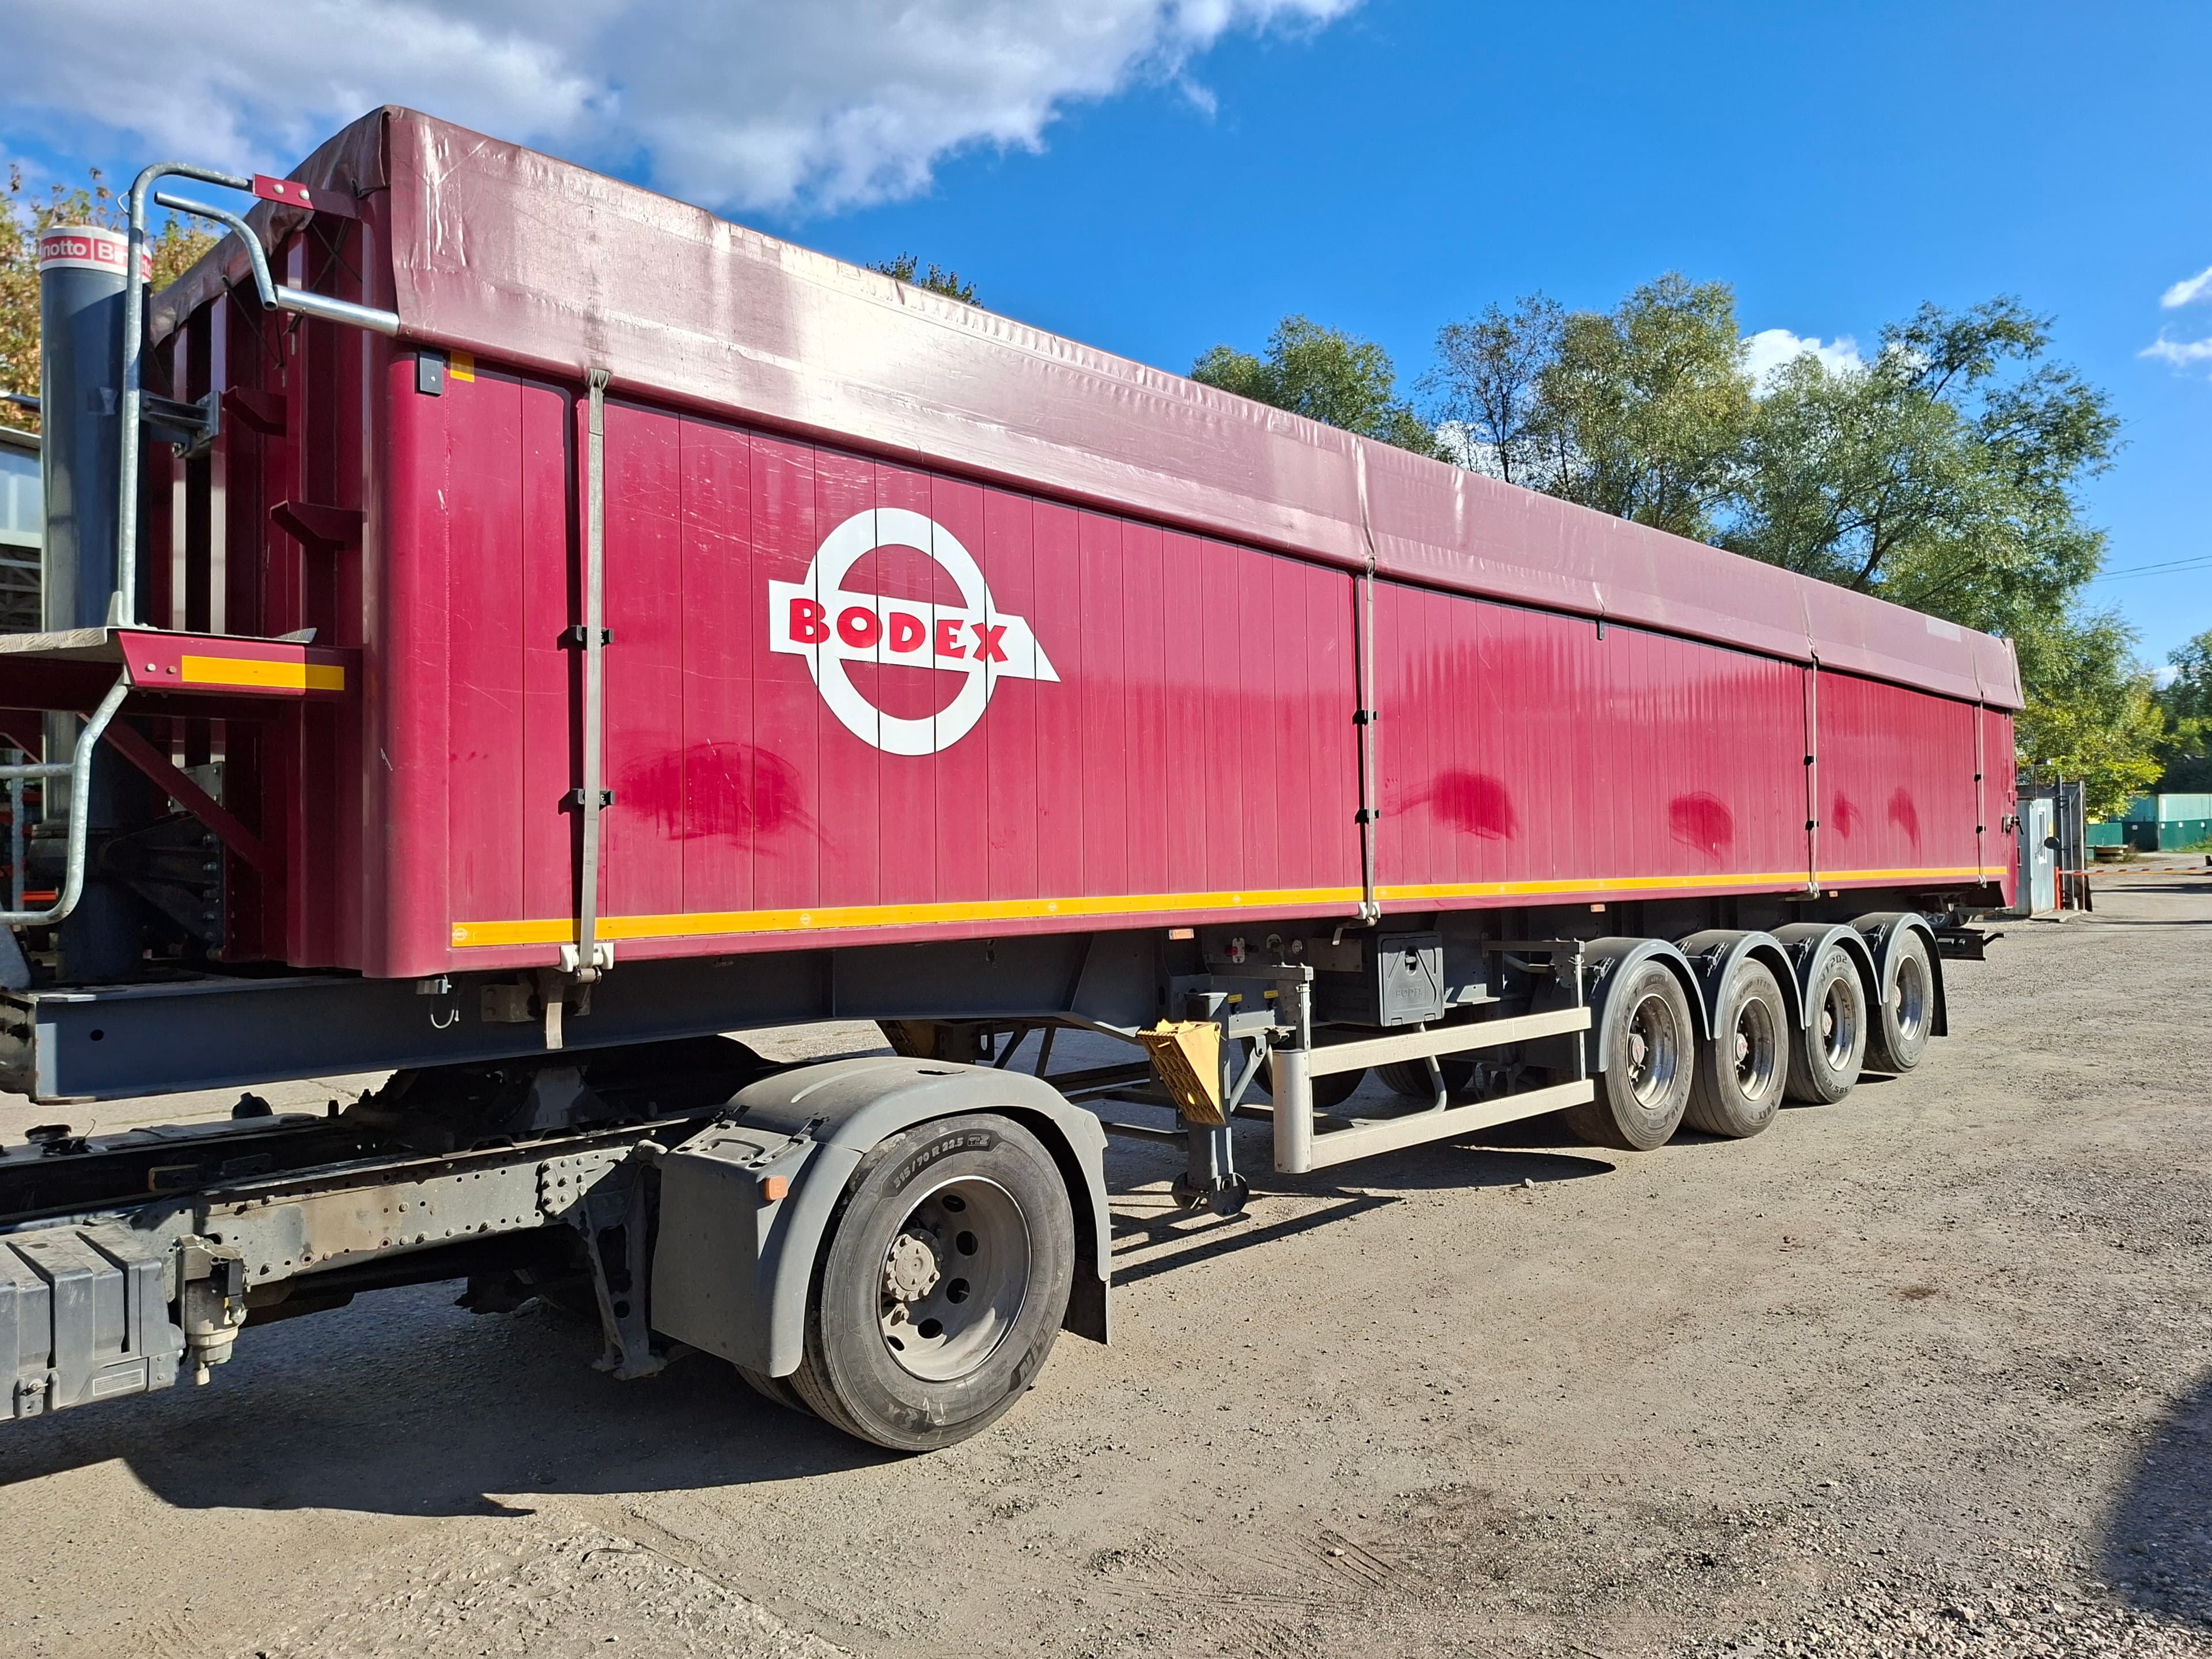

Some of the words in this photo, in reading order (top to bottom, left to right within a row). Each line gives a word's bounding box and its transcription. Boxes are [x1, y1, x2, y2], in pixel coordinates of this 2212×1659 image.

[40, 240, 87, 259] inotto
[790, 598, 1008, 663] BODEX
[893, 1152, 930, 1189] 315/70
[931, 1145, 941, 1157] R
[942, 1137, 964, 1153] 22.5
